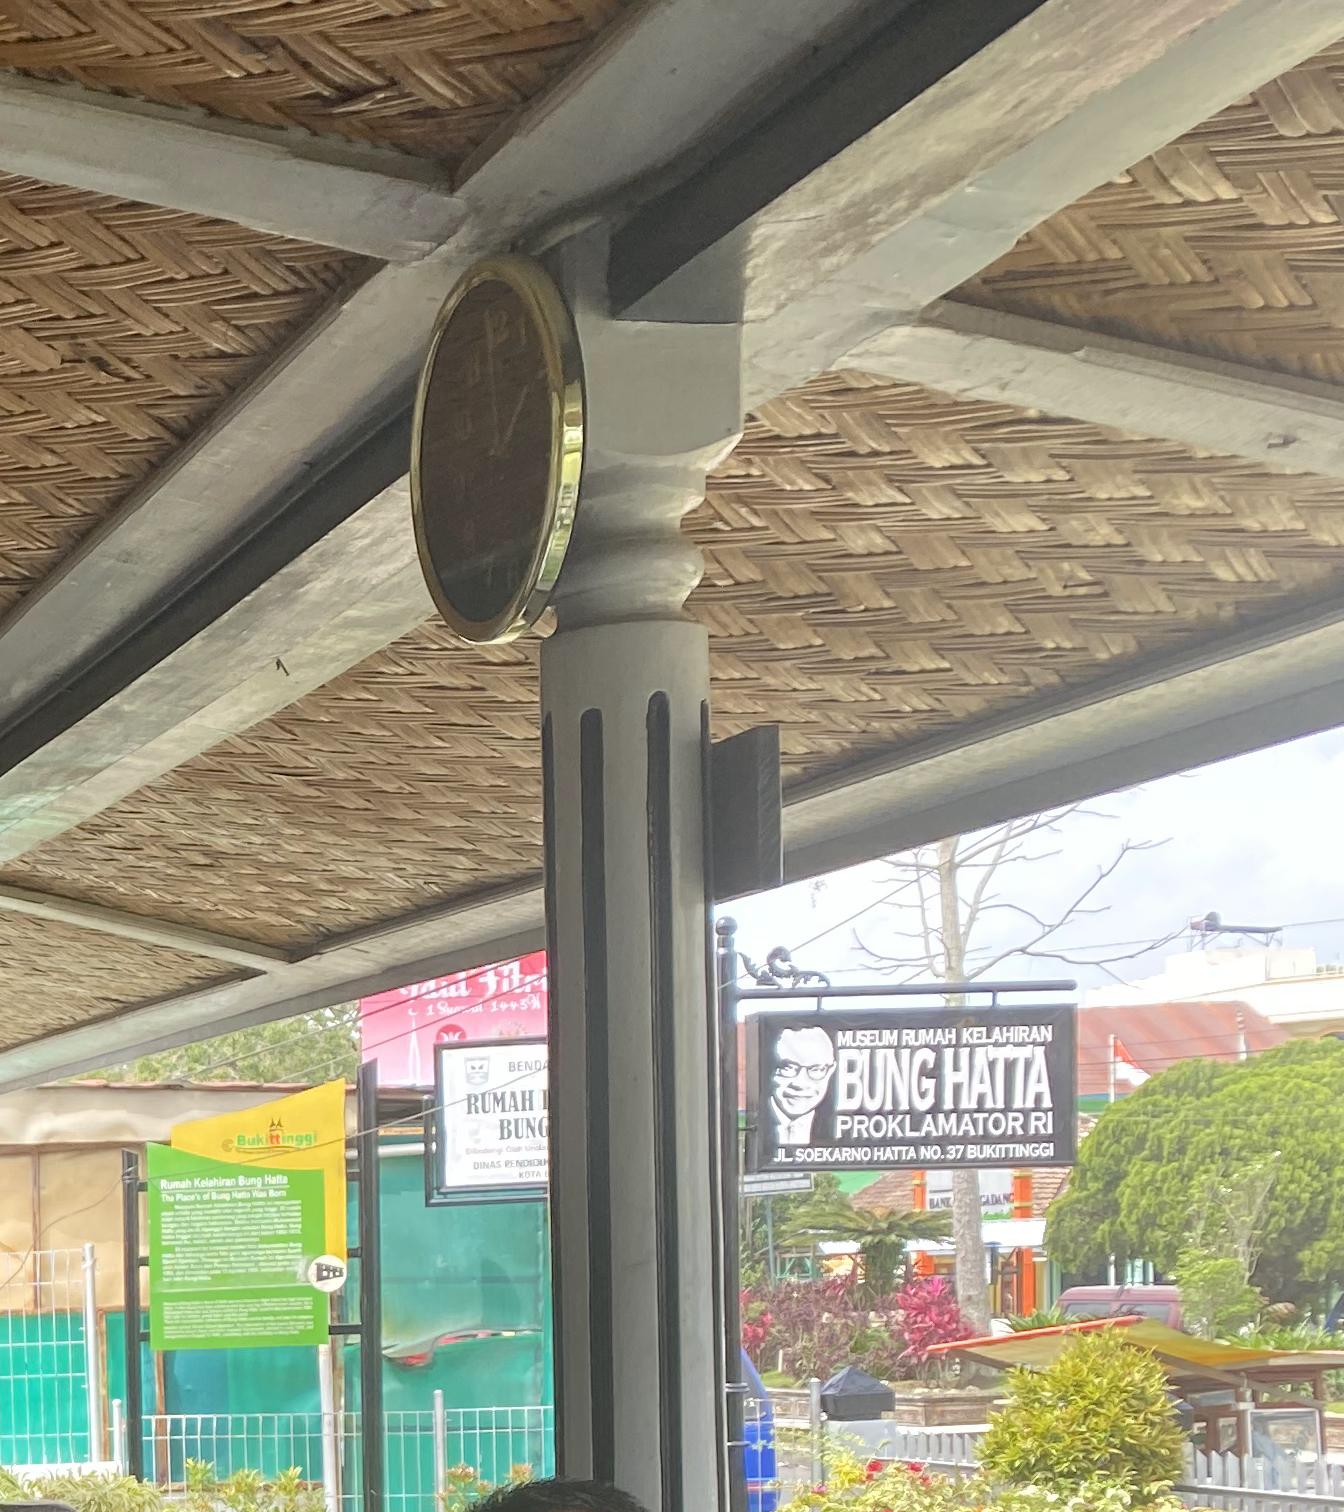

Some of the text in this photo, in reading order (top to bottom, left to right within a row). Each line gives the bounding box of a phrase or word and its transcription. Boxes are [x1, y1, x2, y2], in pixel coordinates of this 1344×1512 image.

[837, 1025, 1053, 1047] MUSEUM RUMAH KELAHIRAN
[836, 1045, 1053, 1112] BUNG HATTA
[466, 1090, 534, 1115] RUMAH
[499, 1117, 548, 1140] BUNG
[835, 1112, 1054, 1139] PROKLAMATOR RI
[237, 1131, 318, 1147] Bukittinggi
[796, 1147, 872, 1162] SOEKARNO
[873, 1146, 917, 1161] HATTA
[920, 1145, 945, 1160] NO.
[947, 1144, 964, 1159] 37
[967, 1143, 1054, 1159] BUKITTINGGI
[473, 1159, 502, 1171] DINAS
[160, 1174, 288, 1190] Rumah Kelahiran Bung Hatta
[161, 1193, 175, 1202] The
[202, 1191, 210, 1200] of
[211, 1191, 230, 1202] Bung
